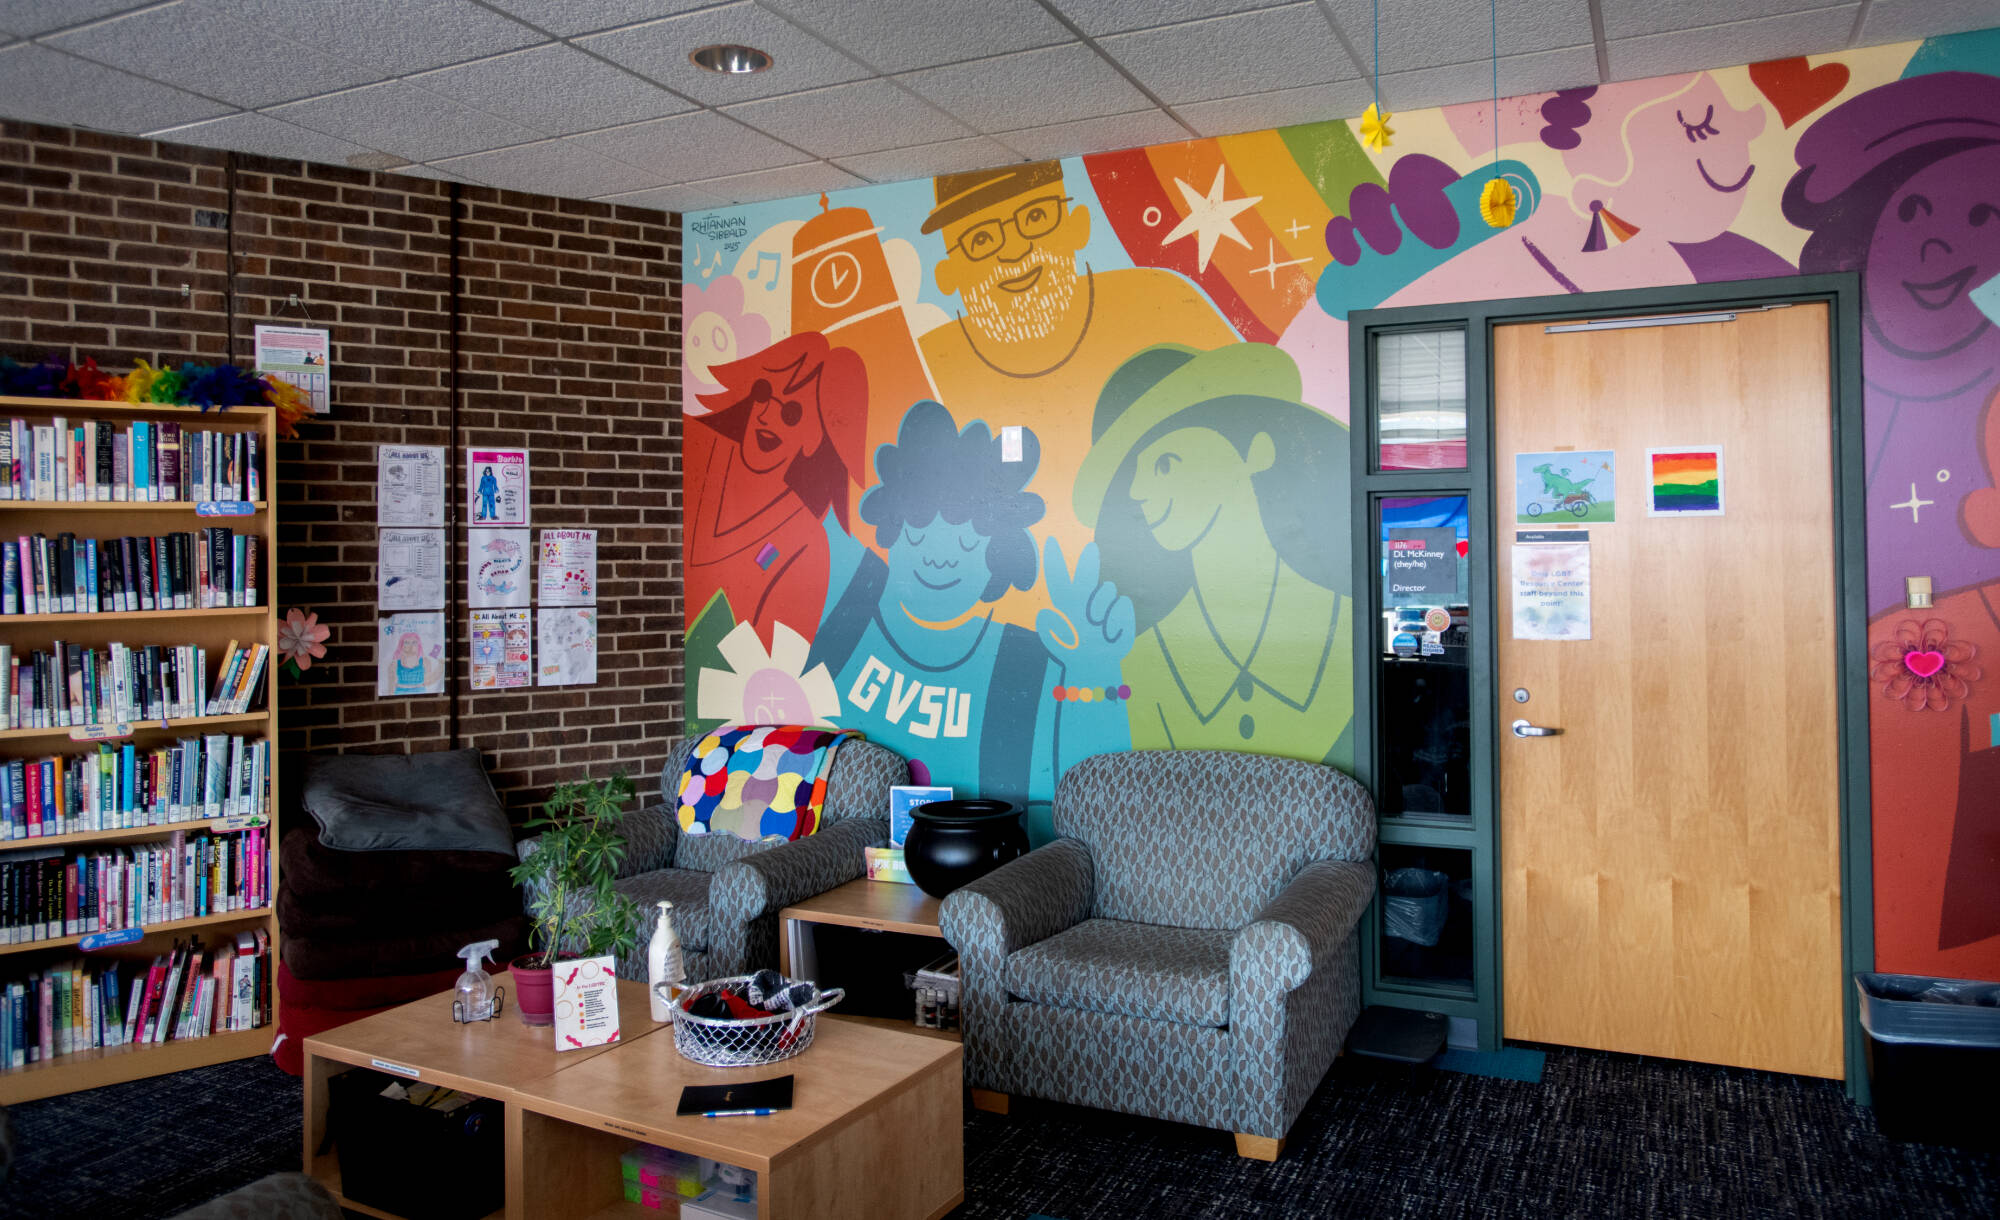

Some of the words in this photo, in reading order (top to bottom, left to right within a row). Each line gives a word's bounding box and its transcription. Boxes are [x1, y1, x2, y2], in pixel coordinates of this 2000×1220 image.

[691, 213, 746, 234] RHIANNAN
[708, 228, 748, 240] SIBBALD
[216, 528, 224, 550] ANNE
[557, 531, 580, 540] ABOUT
[216, 550, 224, 566] RICE
[1407, 550, 1445, 560] McKinney
[1394, 560, 1426, 568] (they/he)
[848, 654, 971, 739] GVSU
